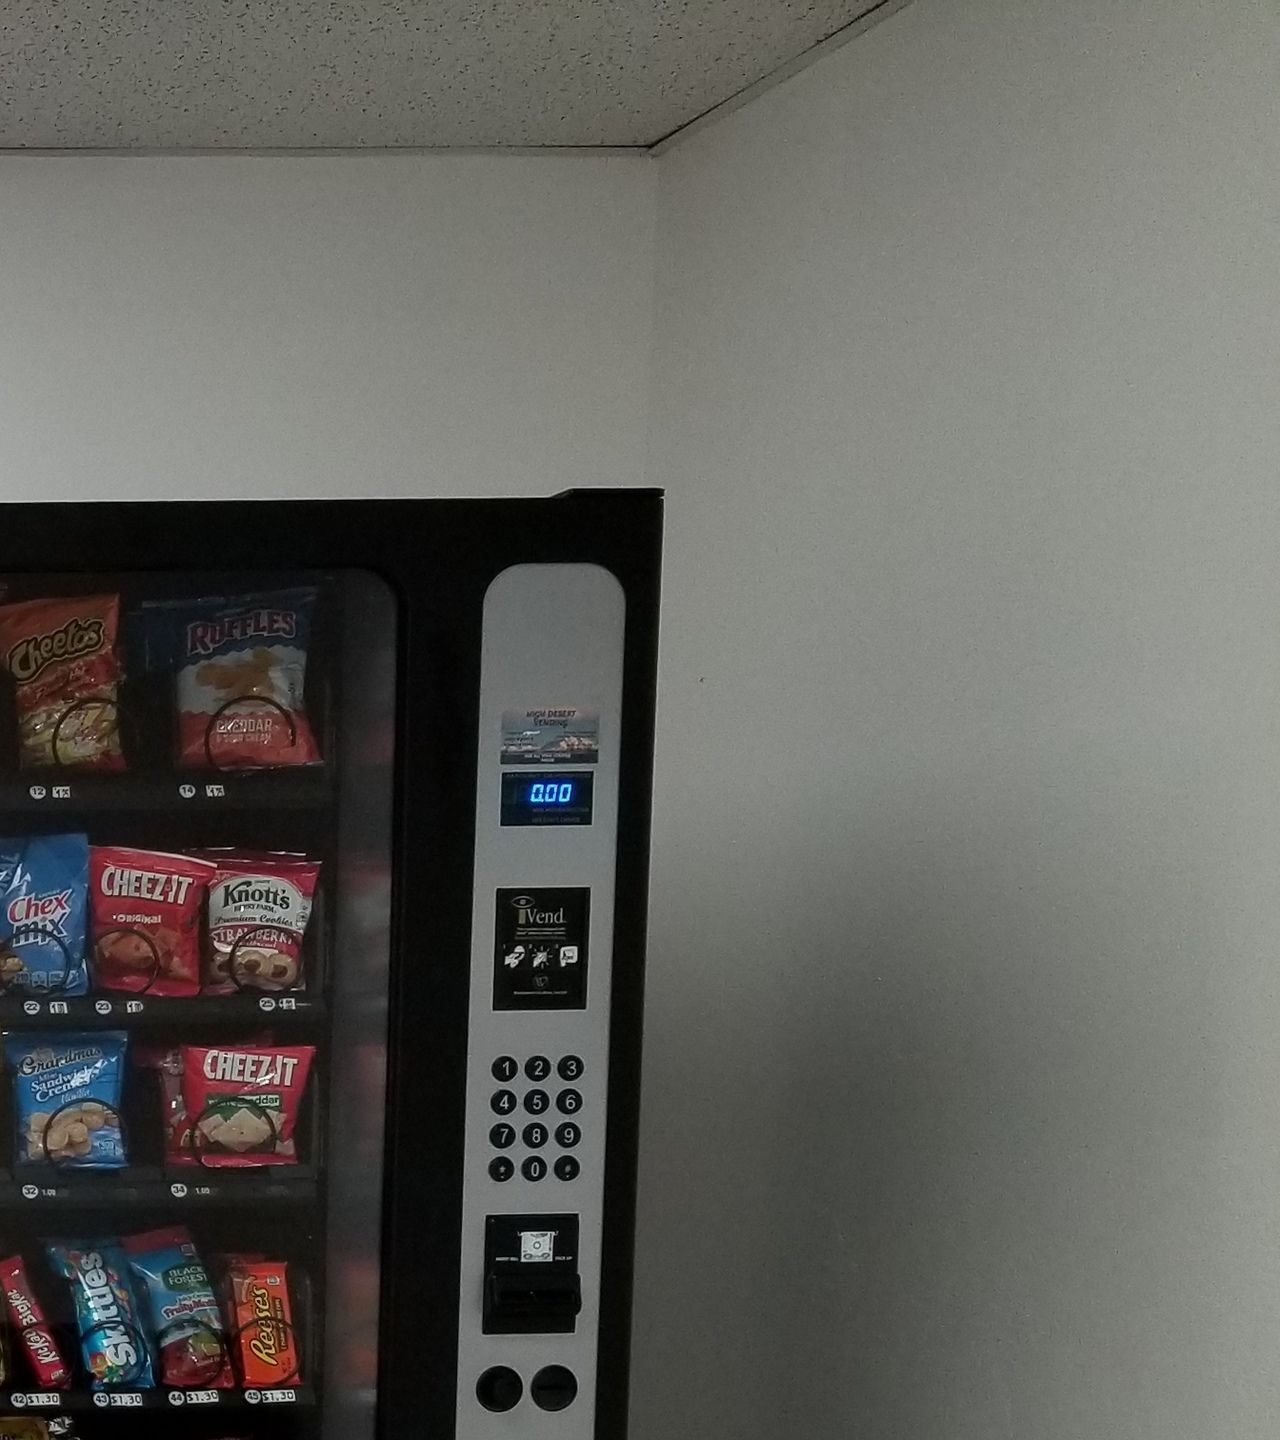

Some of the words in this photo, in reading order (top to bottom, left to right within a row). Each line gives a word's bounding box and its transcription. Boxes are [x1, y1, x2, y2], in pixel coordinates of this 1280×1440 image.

[188, 610, 296, 655] RUFFLES
[9, 618, 105, 682] Cheetos
[223, 881, 290, 909] Knott's
[8, 889, 72, 923] Chex
[12, 915, 68, 947] mix
[502, 1061, 510, 1076] 1
[534, 1061, 544, 1076] 2
[567, 1061, 577, 1076] 3
[499, 1095, 509, 1110] 4
[532, 1095, 542, 1110] 5
[565, 1094, 576, 1110] 6
[499, 1129, 509, 1144] 7
[531, 1128, 541, 1144] 8
[564, 1128, 574, 1144] 9
[530, 1162, 539, 1177] 0
[168, 1265, 203, 1277] BLACK
[249, 1286, 279, 1367] Reese's
